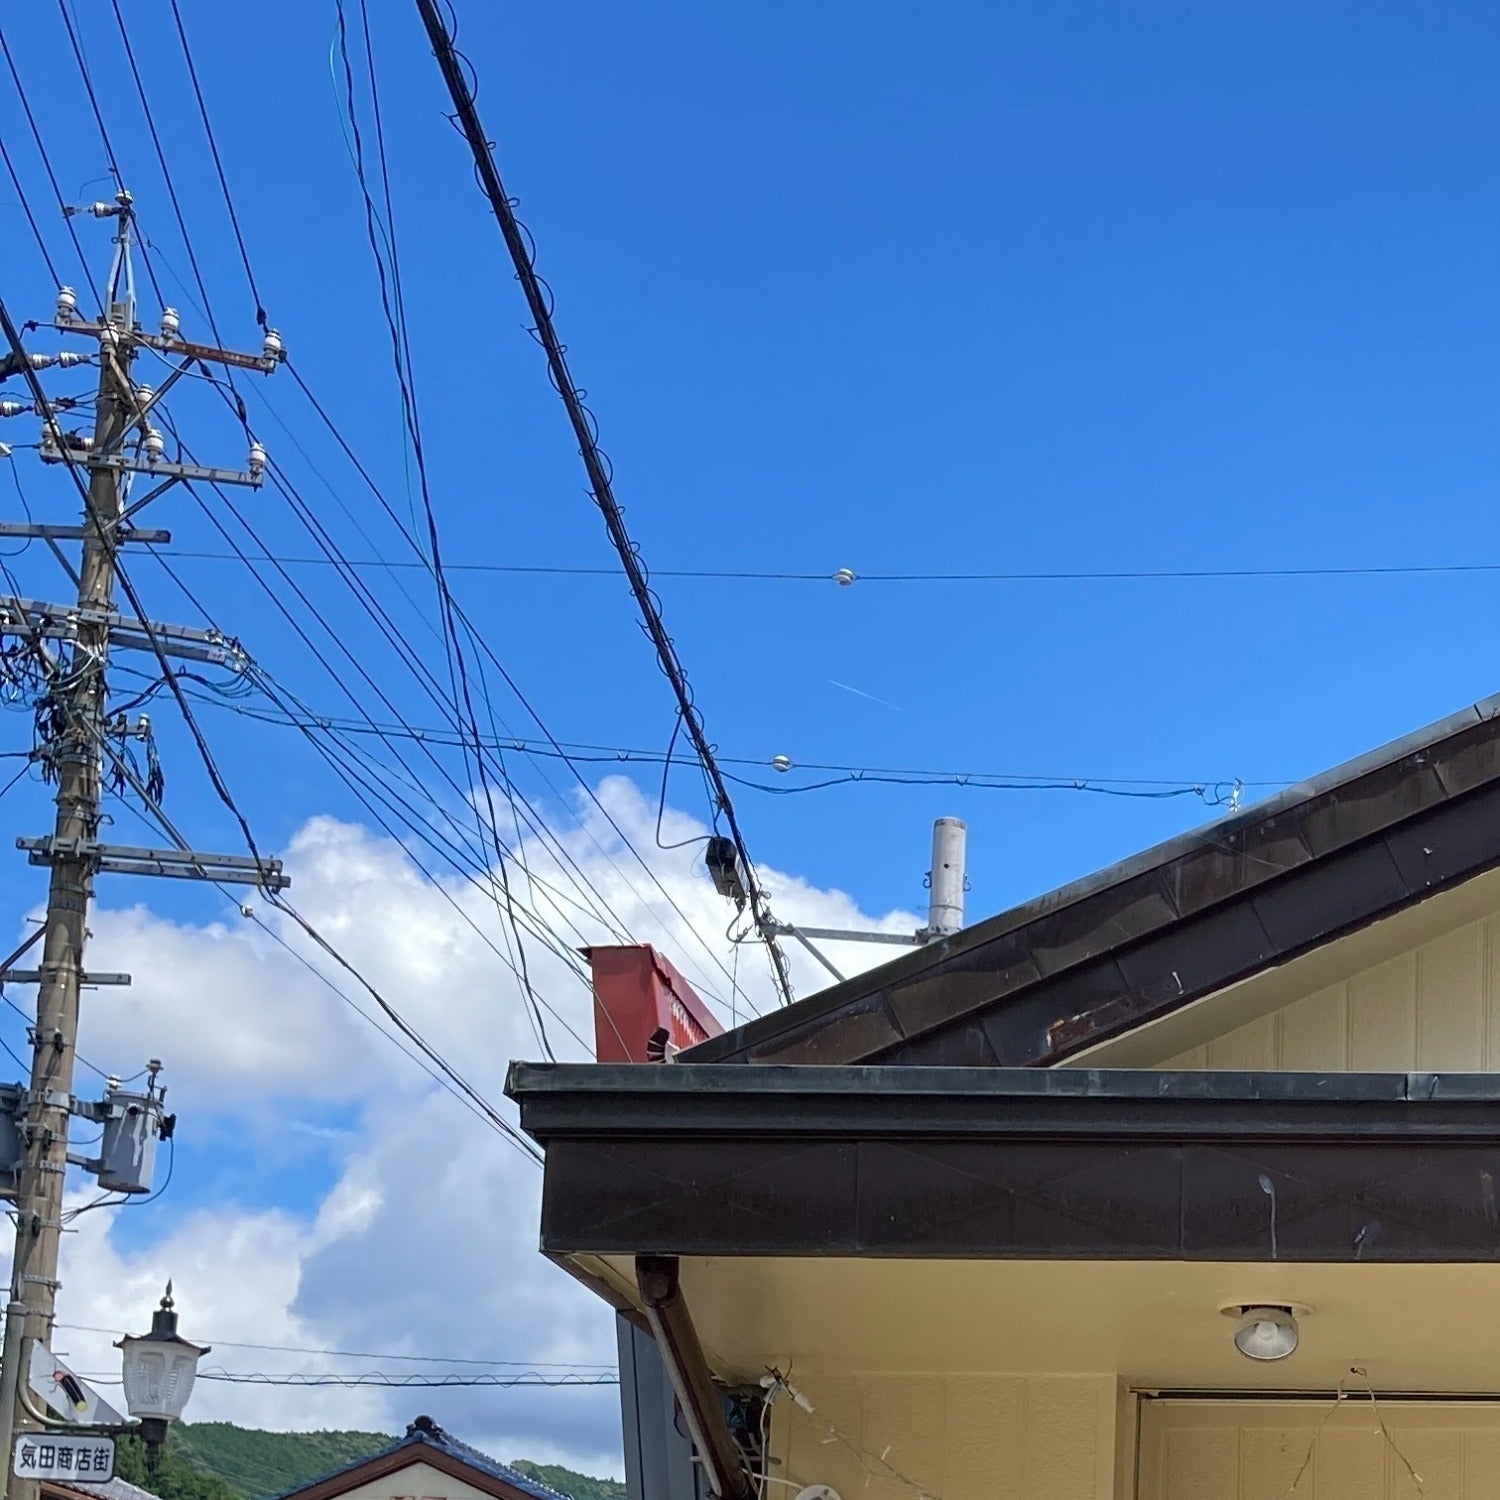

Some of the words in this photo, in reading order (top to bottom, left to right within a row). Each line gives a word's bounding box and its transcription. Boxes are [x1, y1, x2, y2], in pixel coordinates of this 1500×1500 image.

[20, 1443, 110, 1472] 気田商店街
